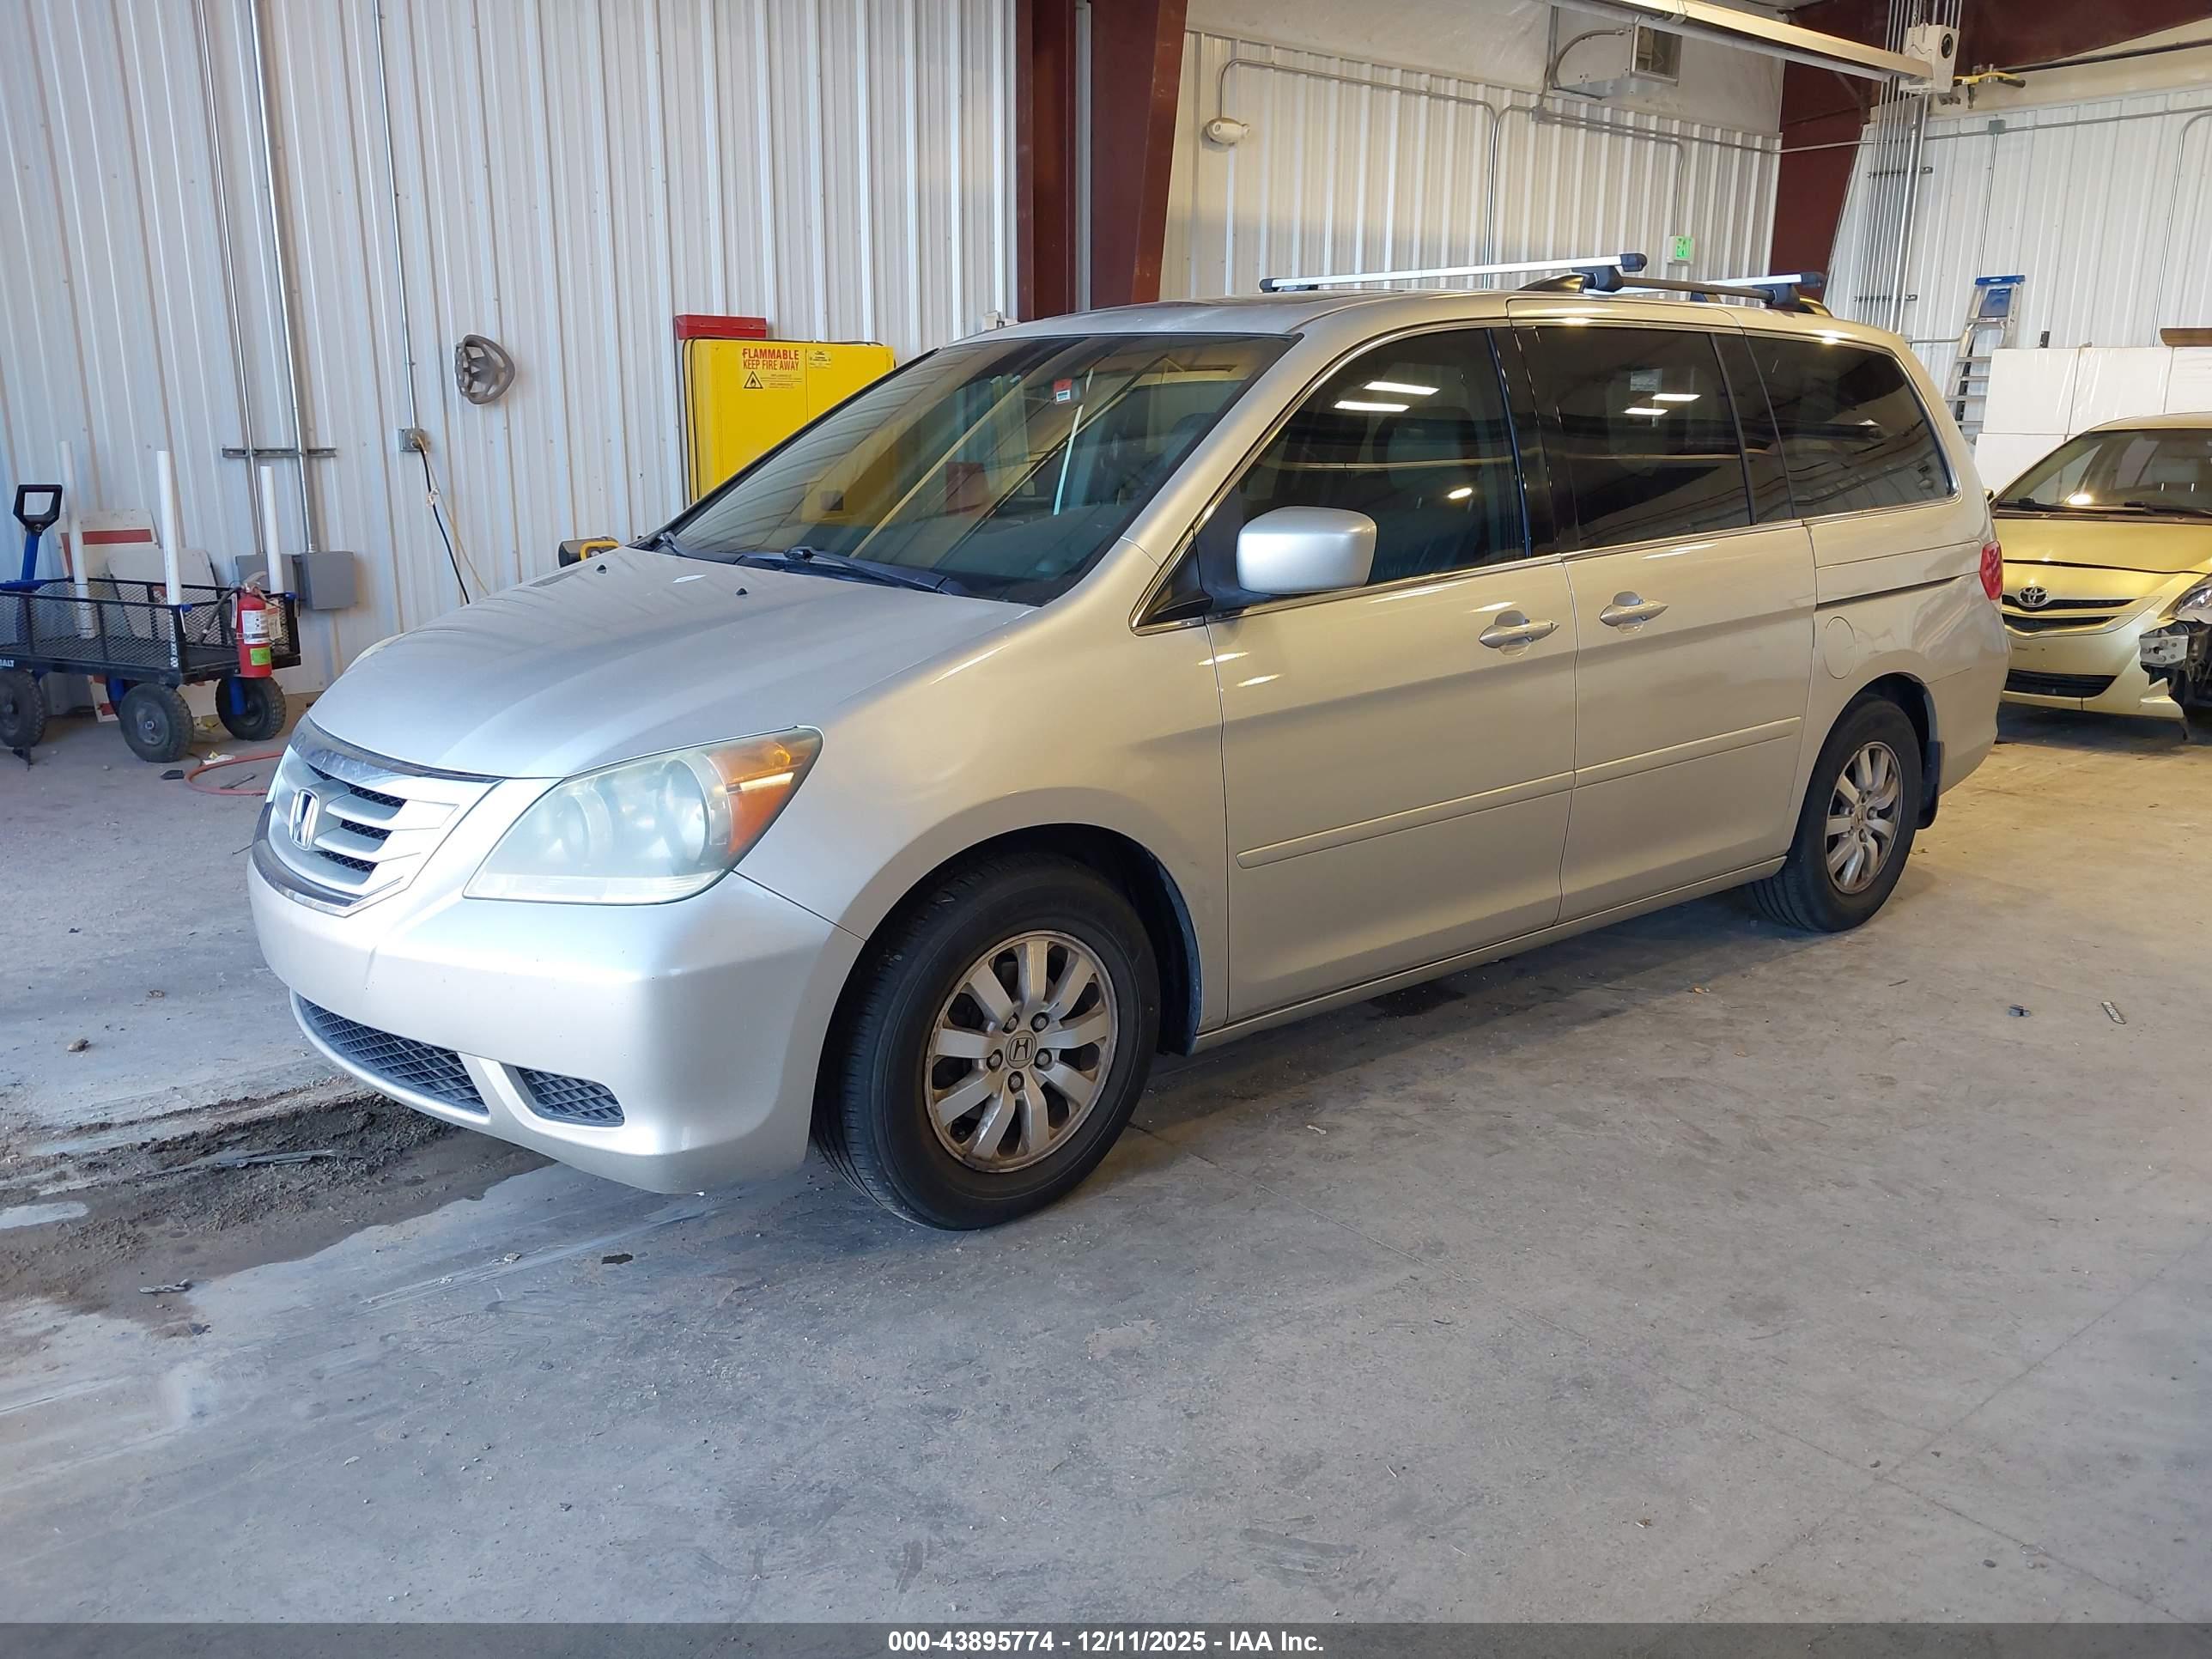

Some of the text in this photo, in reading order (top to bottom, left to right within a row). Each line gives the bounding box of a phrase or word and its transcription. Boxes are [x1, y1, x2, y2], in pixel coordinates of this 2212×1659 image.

[743, 348, 799, 360] FLAMMABLE
[743, 359, 760, 369] KEEP
[763, 360, 778, 370] FIRE
[779, 360, 799, 371] AWAY
